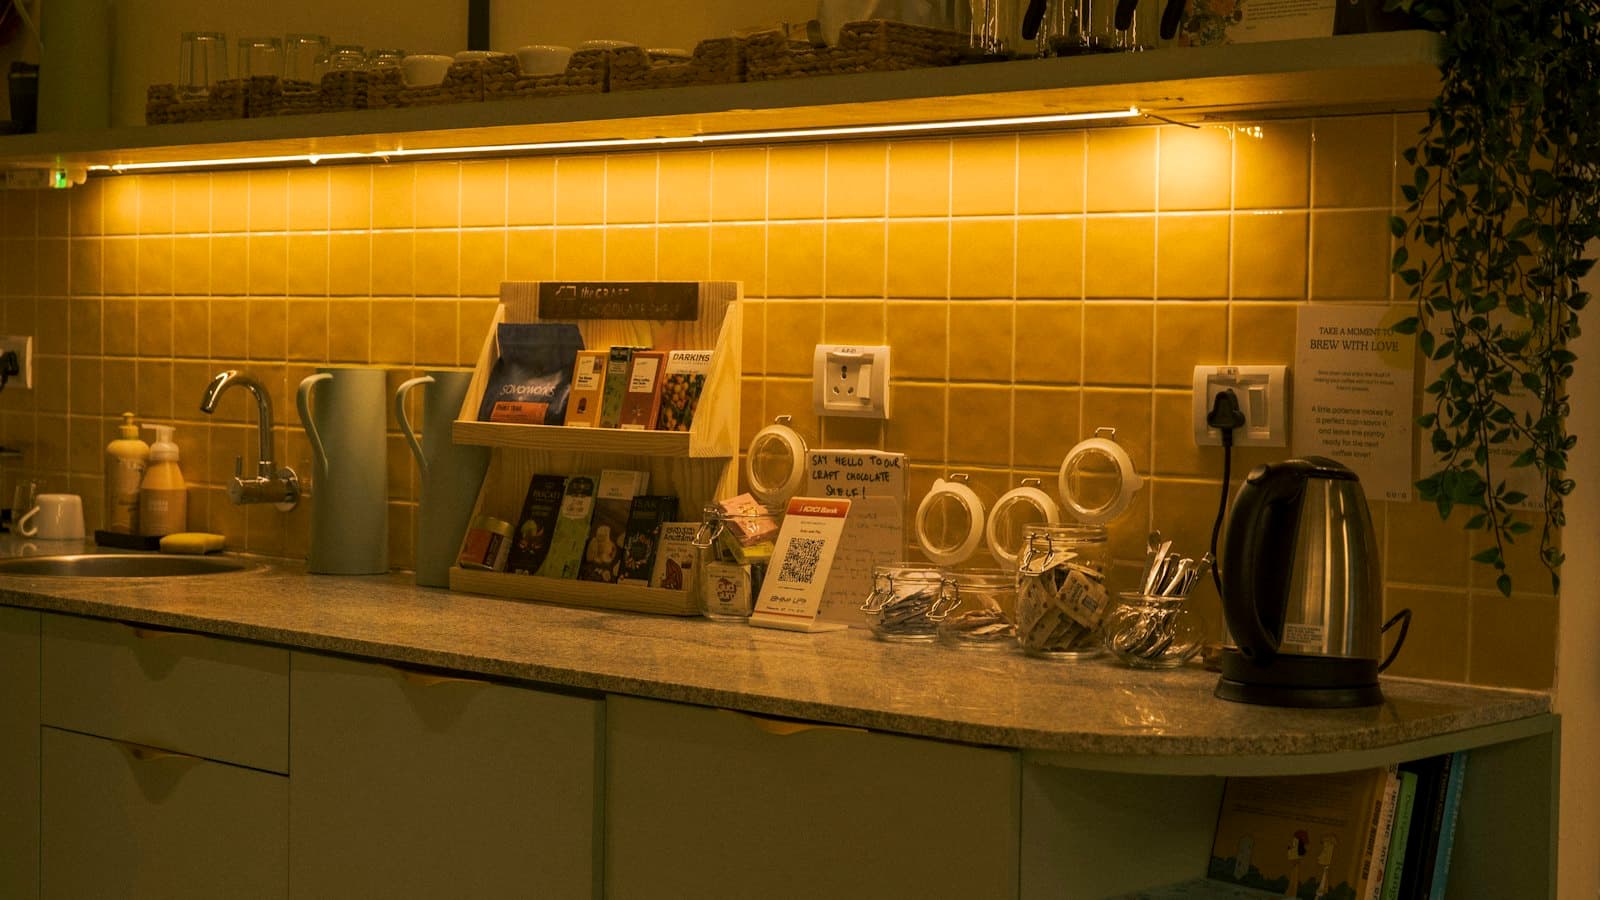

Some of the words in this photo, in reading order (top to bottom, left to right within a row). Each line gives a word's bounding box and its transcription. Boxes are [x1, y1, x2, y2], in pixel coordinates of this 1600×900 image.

[1319, 327, 1338, 335] TAKE
[1339, 327, 1346, 336] A
[1347, 327, 1381, 337] MOMENT
[1310, 338, 1339, 350] BREW
[1342, 339, 1368, 352] WITH
[1371, 340, 1400, 352] LOVE
[673, 353, 710, 362] DARKINS
[812, 455, 827, 466] SAY
[835, 455, 863, 467] HELLO
[812, 470, 840, 480] CRAFT
[846, 470, 890, 482] CHOCOLATE
[821, 506, 838, 514] Bank
